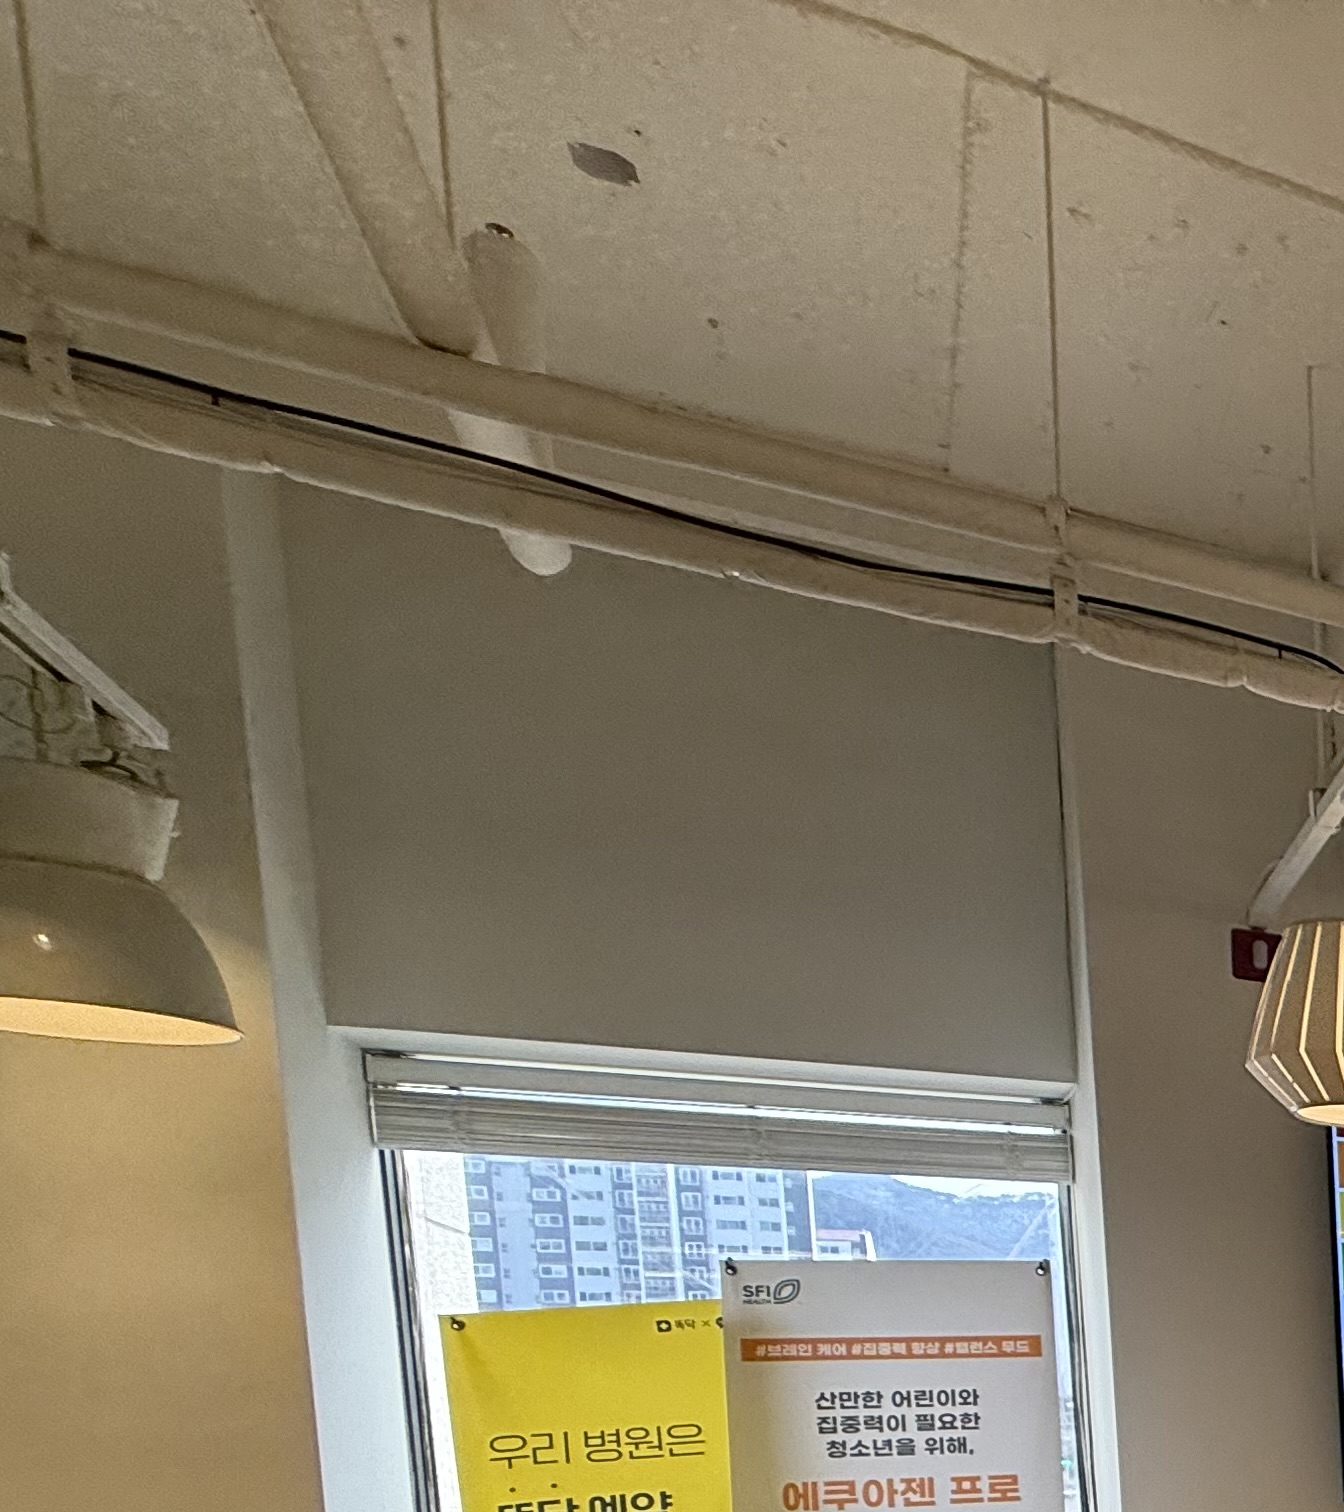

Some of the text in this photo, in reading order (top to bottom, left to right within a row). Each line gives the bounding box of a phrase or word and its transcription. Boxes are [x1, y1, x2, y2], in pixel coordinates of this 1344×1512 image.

[743, 1285, 771, 1298] SFI
[756, 1344, 812, 1357] #브레인
[816, 1343, 847, 1356] 케어
[852, 1342, 906, 1356] #집중력
[911, 1342, 940, 1355] 향상
[945, 1341, 997, 1355] #밸런스
[815, 1389, 980, 1410] 산만한 어린이와
[816, 1412, 981, 1434] 집중력이 필요한
[489, 1423, 706, 1469] 우리 병원은
[826, 1438, 916, 1459] 청소년을
[782, 1473, 1022, 1512] 에쿠아젠 프로
